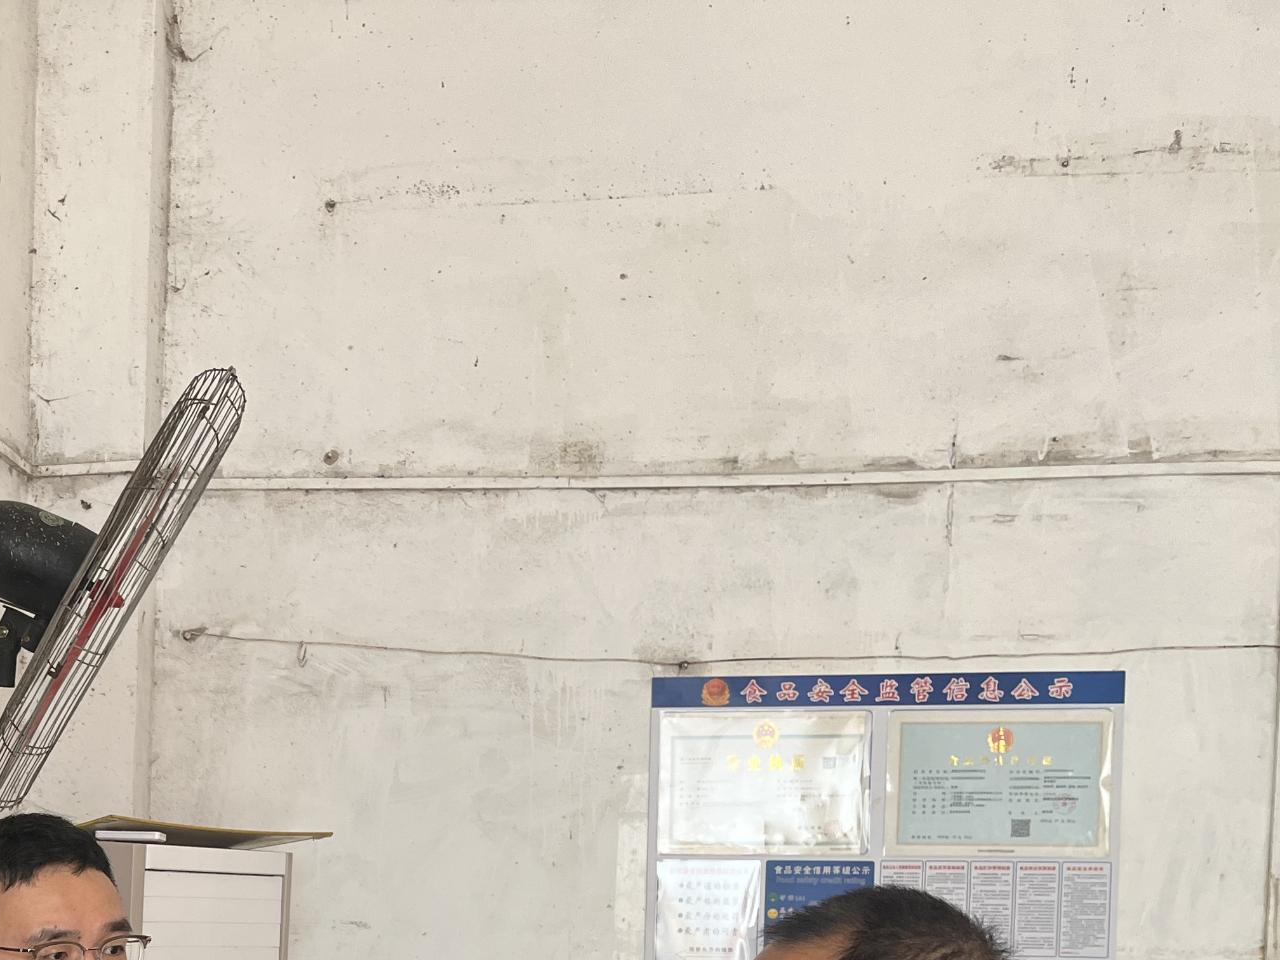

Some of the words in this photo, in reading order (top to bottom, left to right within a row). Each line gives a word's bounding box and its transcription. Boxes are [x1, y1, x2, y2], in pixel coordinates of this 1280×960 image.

[740, 677, 1073, 703] 食品安全监管信息公示
